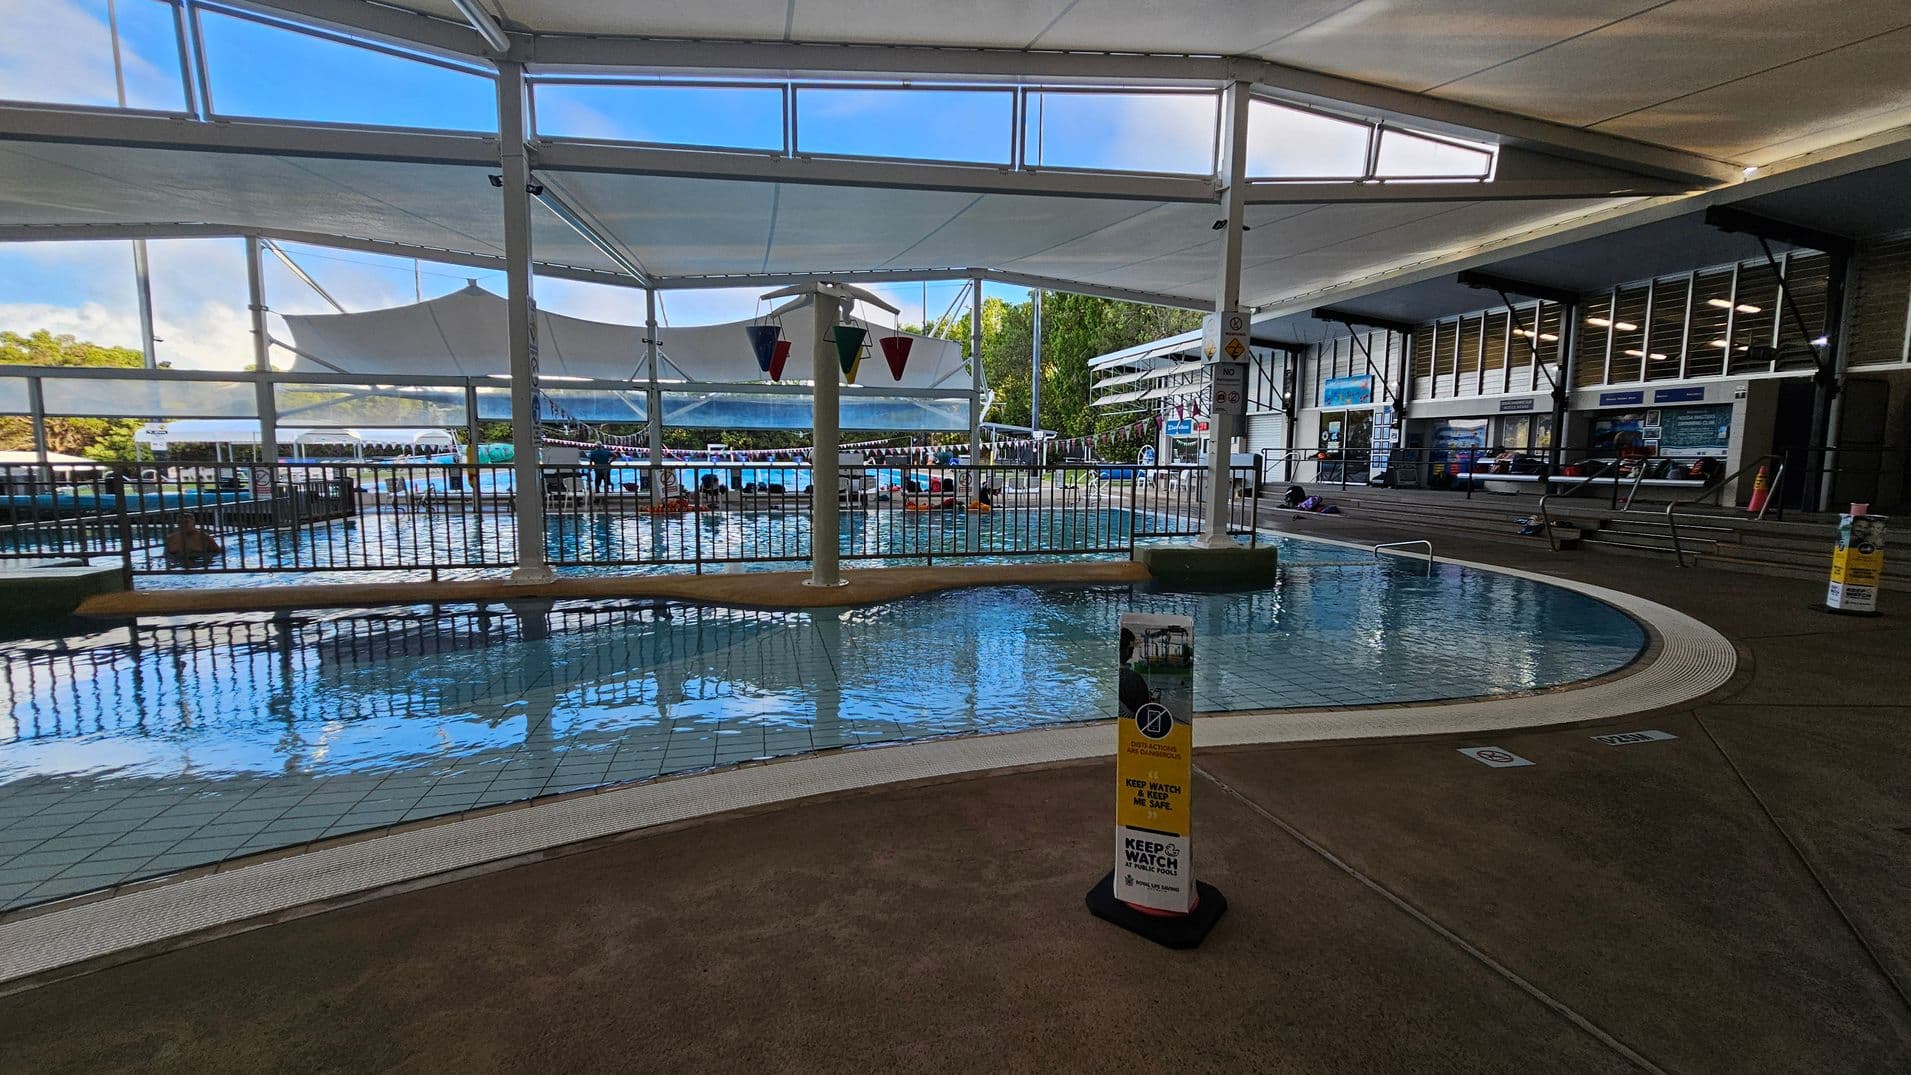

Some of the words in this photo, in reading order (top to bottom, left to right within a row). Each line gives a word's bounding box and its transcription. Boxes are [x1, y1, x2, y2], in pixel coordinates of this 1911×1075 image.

[1223, 368, 1234, 376] NO
[1130, 741, 1177, 753] DISTRACTIONS
[1140, 749, 1182, 760] DANGEROUS
[1126, 778, 1147, 789] KEEP
[1149, 782, 1181, 794] WATCH
[1138, 789, 1144, 798] &
[1147, 790, 1169, 801] KEEP
[1133, 797, 1146, 807] ME
[1149, 799, 1173, 811] SAFE.
[1125, 838, 1165, 854] KEEP
[1125, 850, 1178, 870] WATCH
[1134, 863, 1154, 873] PUBLIC
[1156, 867, 1178, 877] POOLS
[1135, 880, 1150, 888] ROYAL
[1161, 884, 1180, 893] SAVING
